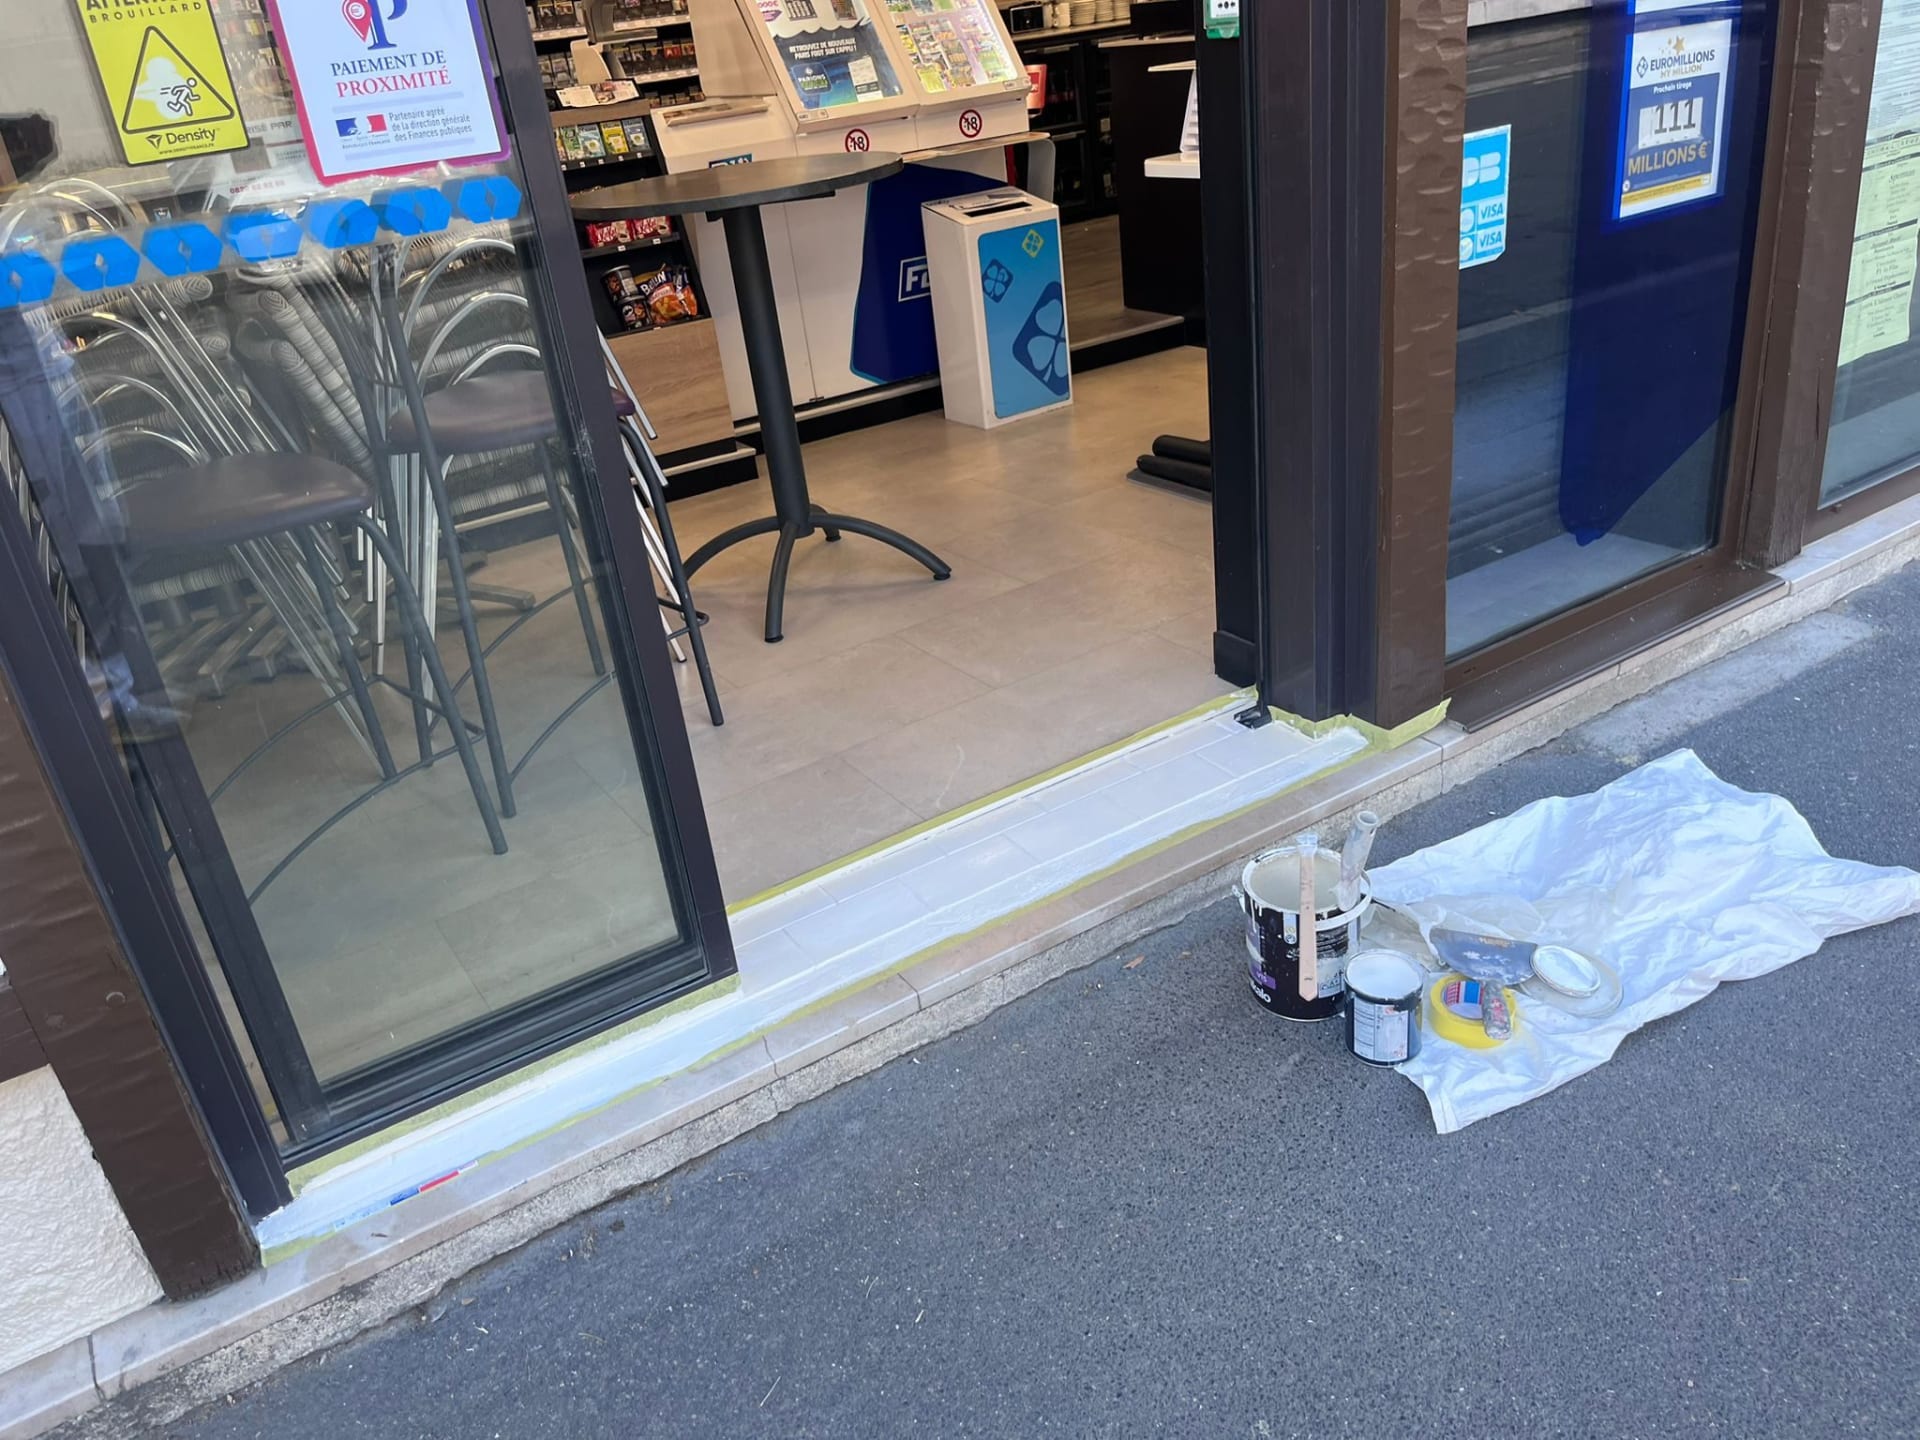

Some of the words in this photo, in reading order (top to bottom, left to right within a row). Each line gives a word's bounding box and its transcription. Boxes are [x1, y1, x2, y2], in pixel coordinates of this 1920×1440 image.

[89, 2, 202, 23] BROUILLARD
[330, 53, 418, 77] PAIEMENT
[421, 50, 447, 66] DE
[1650, 49, 1715, 71] EUROMILLIONS
[1672, 63, 1703, 78] MILLION
[336, 65, 452, 98] PROXIMITÉ
[1653, 83, 1676, 95] Prochain
[1676, 80, 1692, 92] tirage
[388, 110, 425, 121] Partenaire
[426, 106, 446, 119] agréé
[1654, 98, 1696, 135] 111
[392, 123, 400, 132] de
[400, 121, 410, 131] la
[410, 118, 441, 130] direction
[441, 114, 471, 127] générale
[166, 127, 216, 145] Density
[394, 133, 407, 142] des
[408, 128, 439, 141] Finances
[440, 124, 473, 138] publiques
[1628, 144, 1697, 177] MILLIONS
[1480, 202, 1504, 220] VISA
[1479, 231, 1502, 248] VISA
